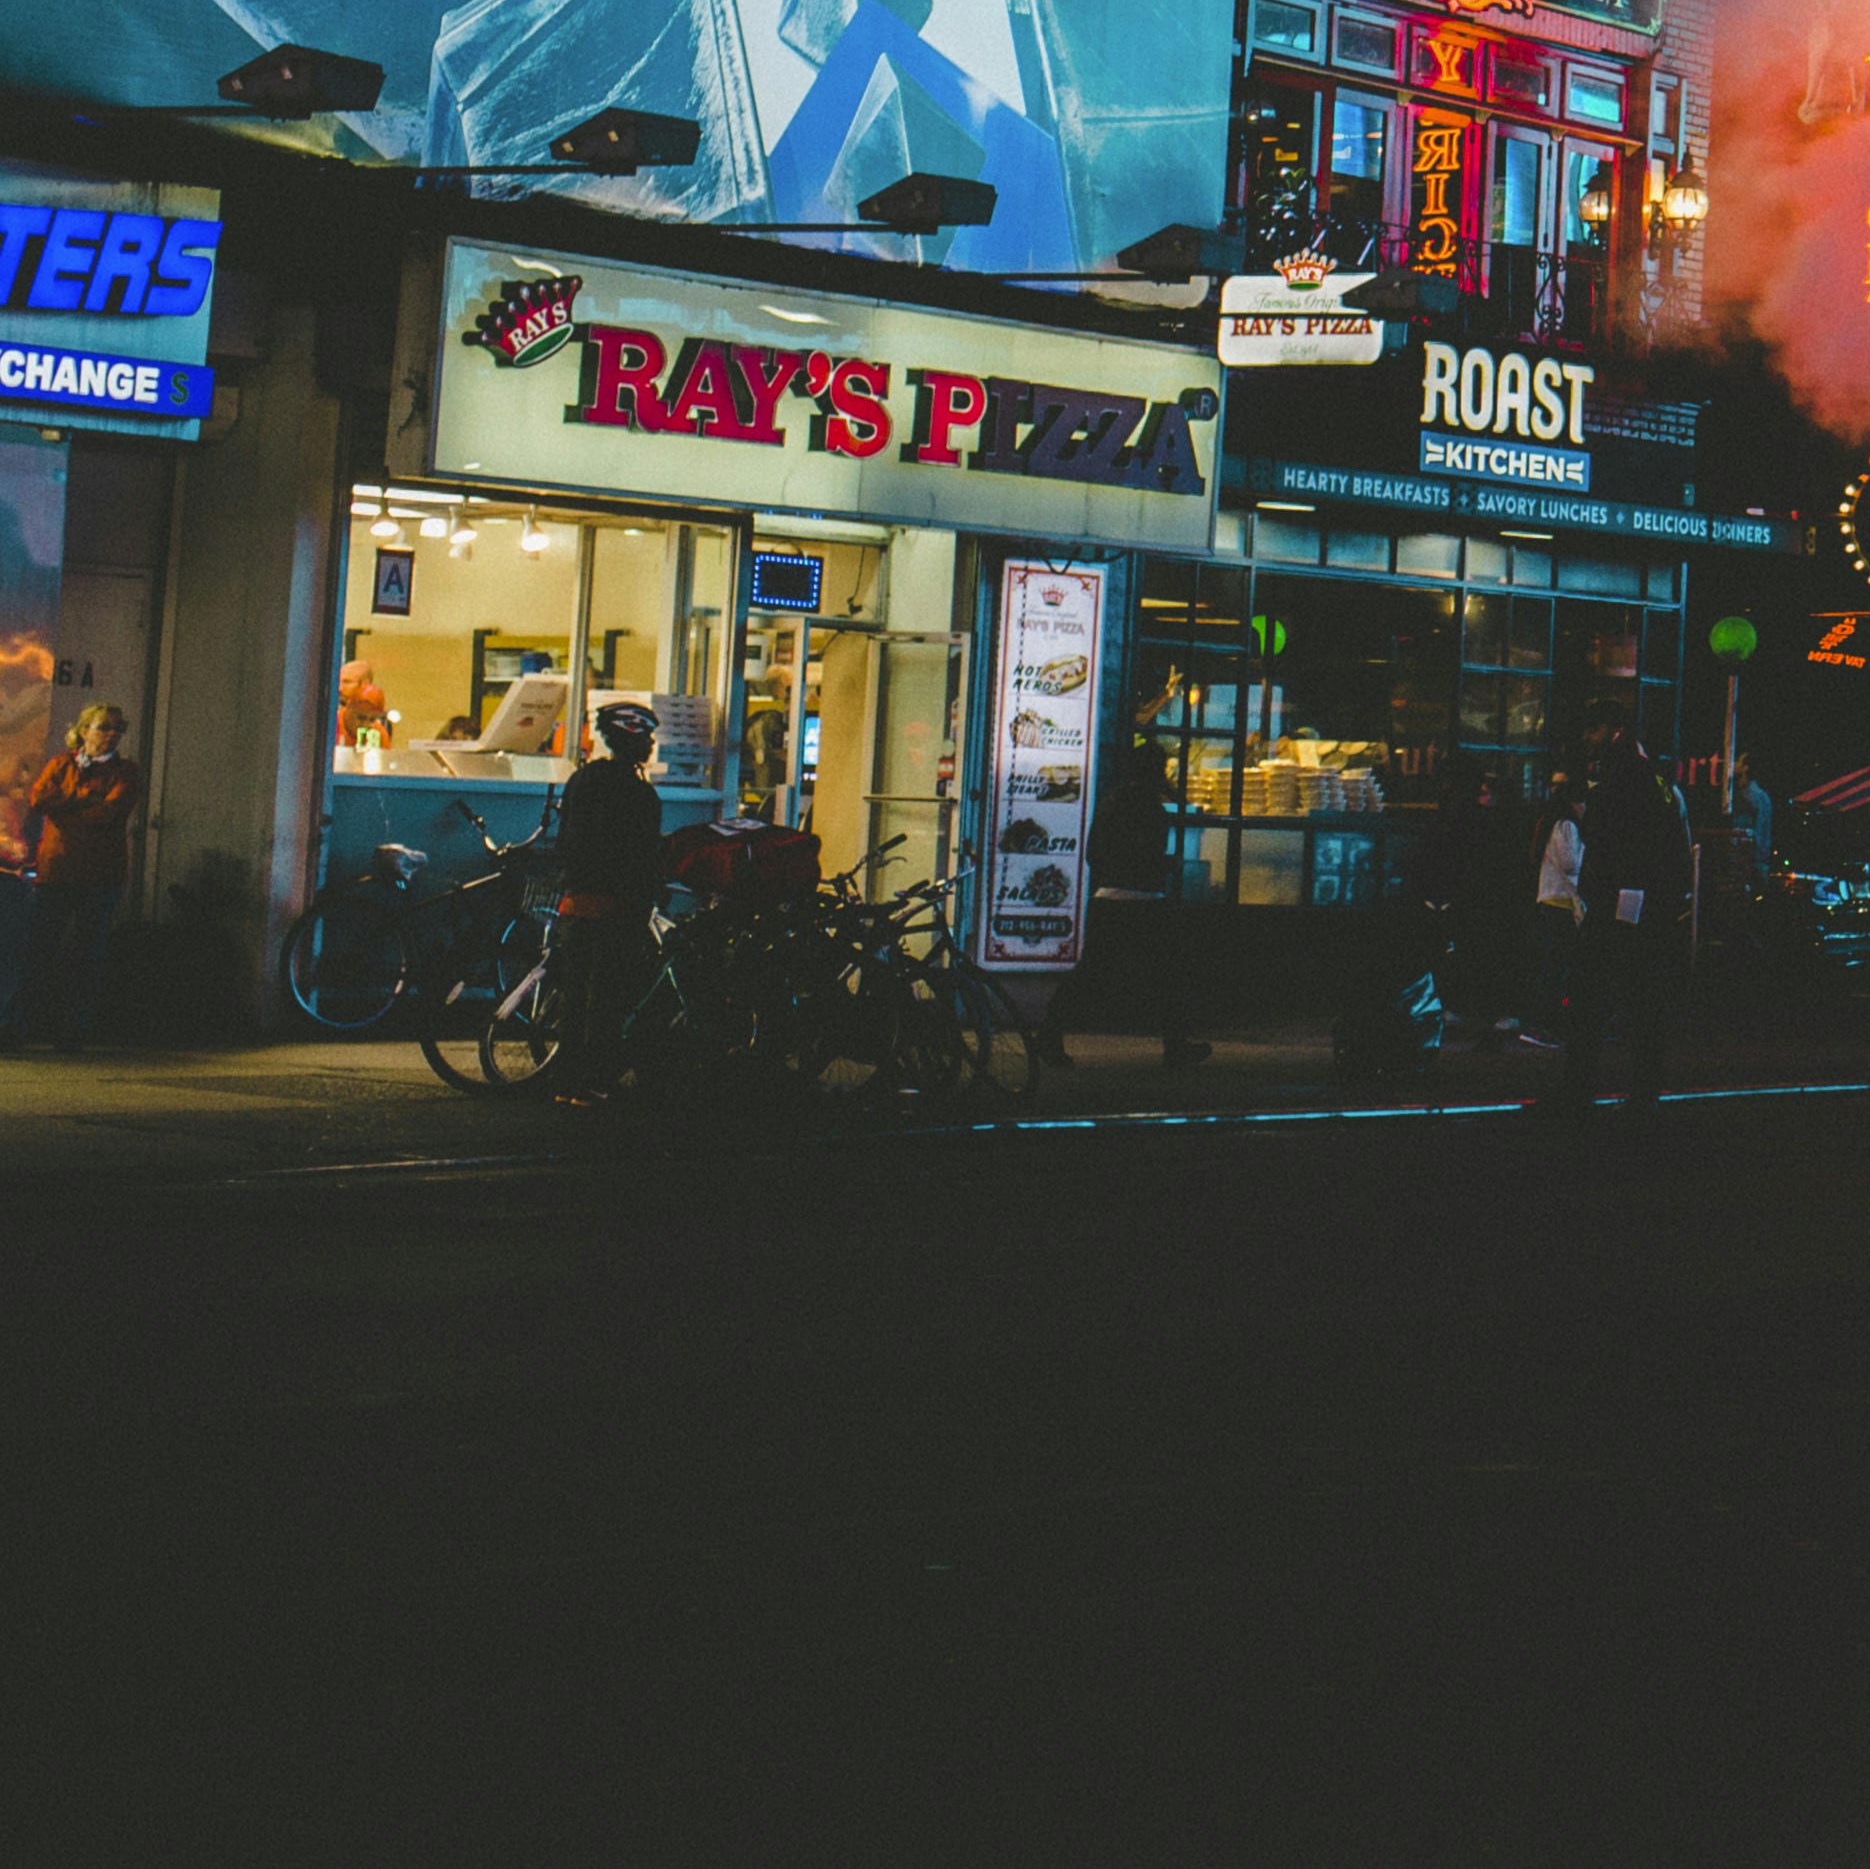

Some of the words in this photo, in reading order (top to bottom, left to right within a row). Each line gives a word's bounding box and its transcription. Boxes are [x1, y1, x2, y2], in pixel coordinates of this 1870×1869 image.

[1305, 316, 1373, 335] PIZZA
[0, 348, 160, 405] CHANGE
[1420, 340, 1595, 445] ROAST
[578, 323, 894, 460] RAY'S
[914, 368, 1207, 497] PIZZA
[1445, 440, 1565, 482] KITCHEN
[1283, 468, 1349, 494] HEARTY
[1352, 473, 1451, 508] BREAKFASTS
[1476, 491, 1537, 519] SAVORY
[1539, 496, 1608, 526] LUNCHES
[1632, 509, 1708, 539] DELICIOUS
[382, 562, 406, 595] A
[1025, 837, 1077, 853] PASTA
[995, 885, 1063, 903] SALADS
